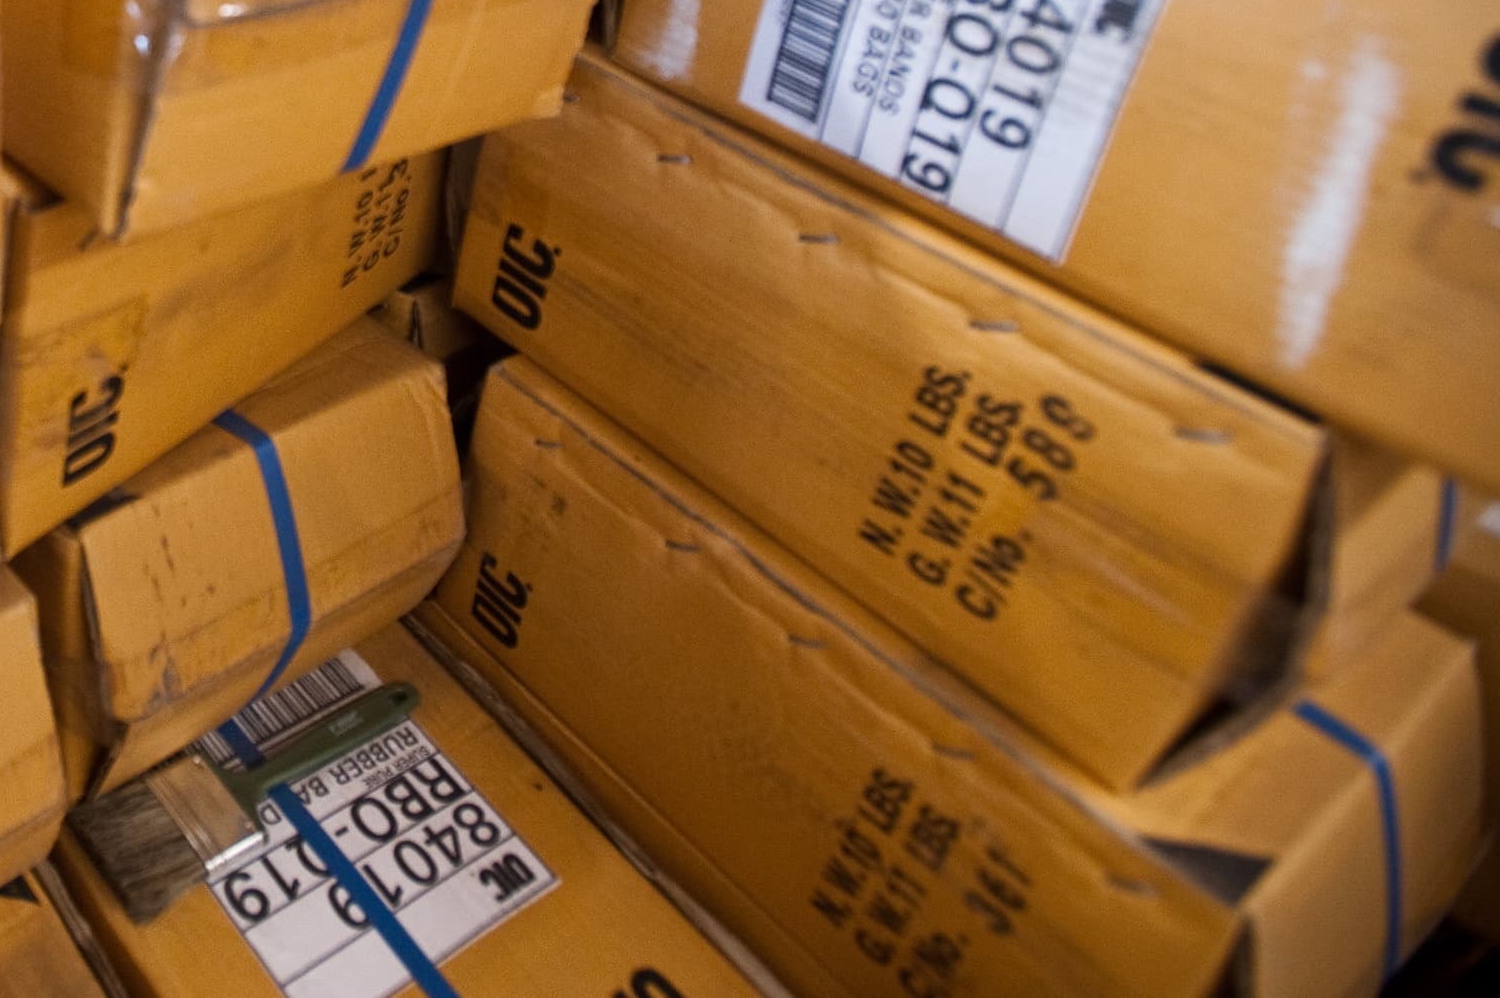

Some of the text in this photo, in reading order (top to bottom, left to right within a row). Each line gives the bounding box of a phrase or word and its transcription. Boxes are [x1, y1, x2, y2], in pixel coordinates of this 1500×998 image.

[853, 26, 882, 99] BAGS
[879, 26, 924, 118] BANDS
[330, 725, 419, 786] RUBBER
